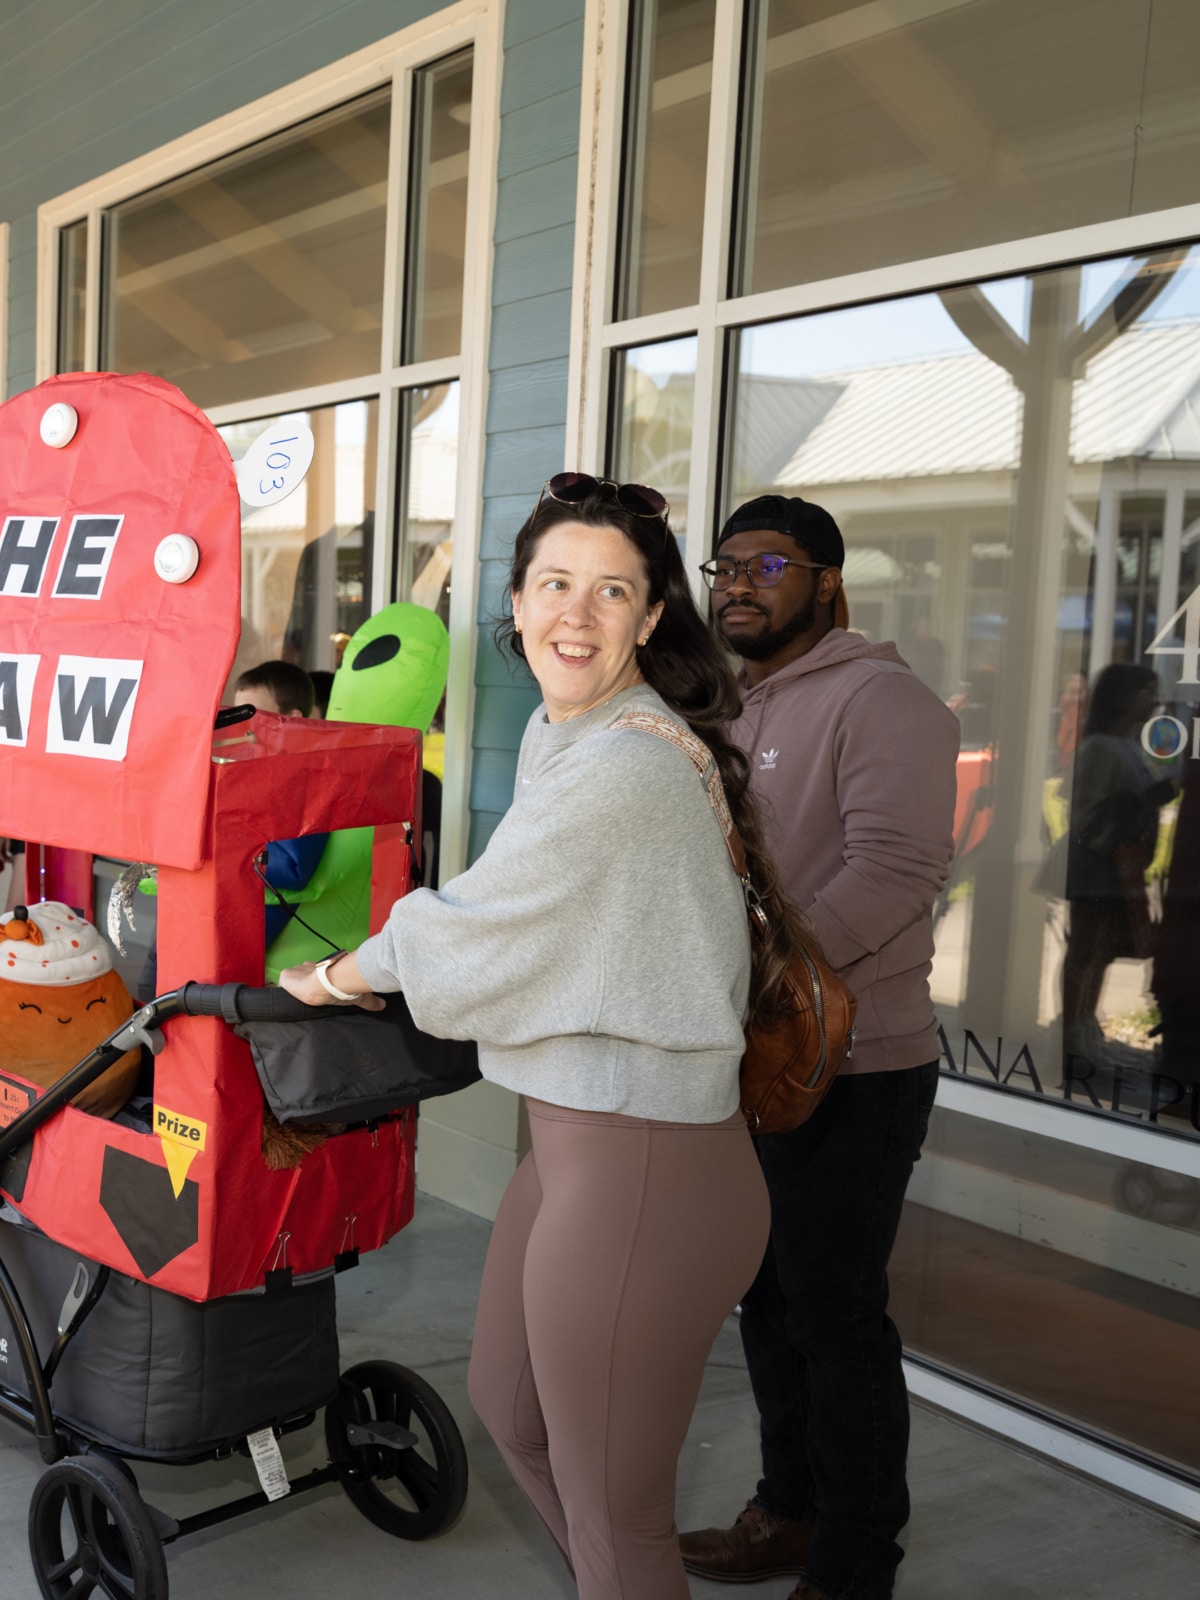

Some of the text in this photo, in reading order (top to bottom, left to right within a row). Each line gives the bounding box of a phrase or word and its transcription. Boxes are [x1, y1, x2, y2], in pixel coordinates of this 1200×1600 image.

[260, 436, 299, 495] 103
[1141, 715, 1200, 760] O
[157, 1111, 201, 1142] Prize
